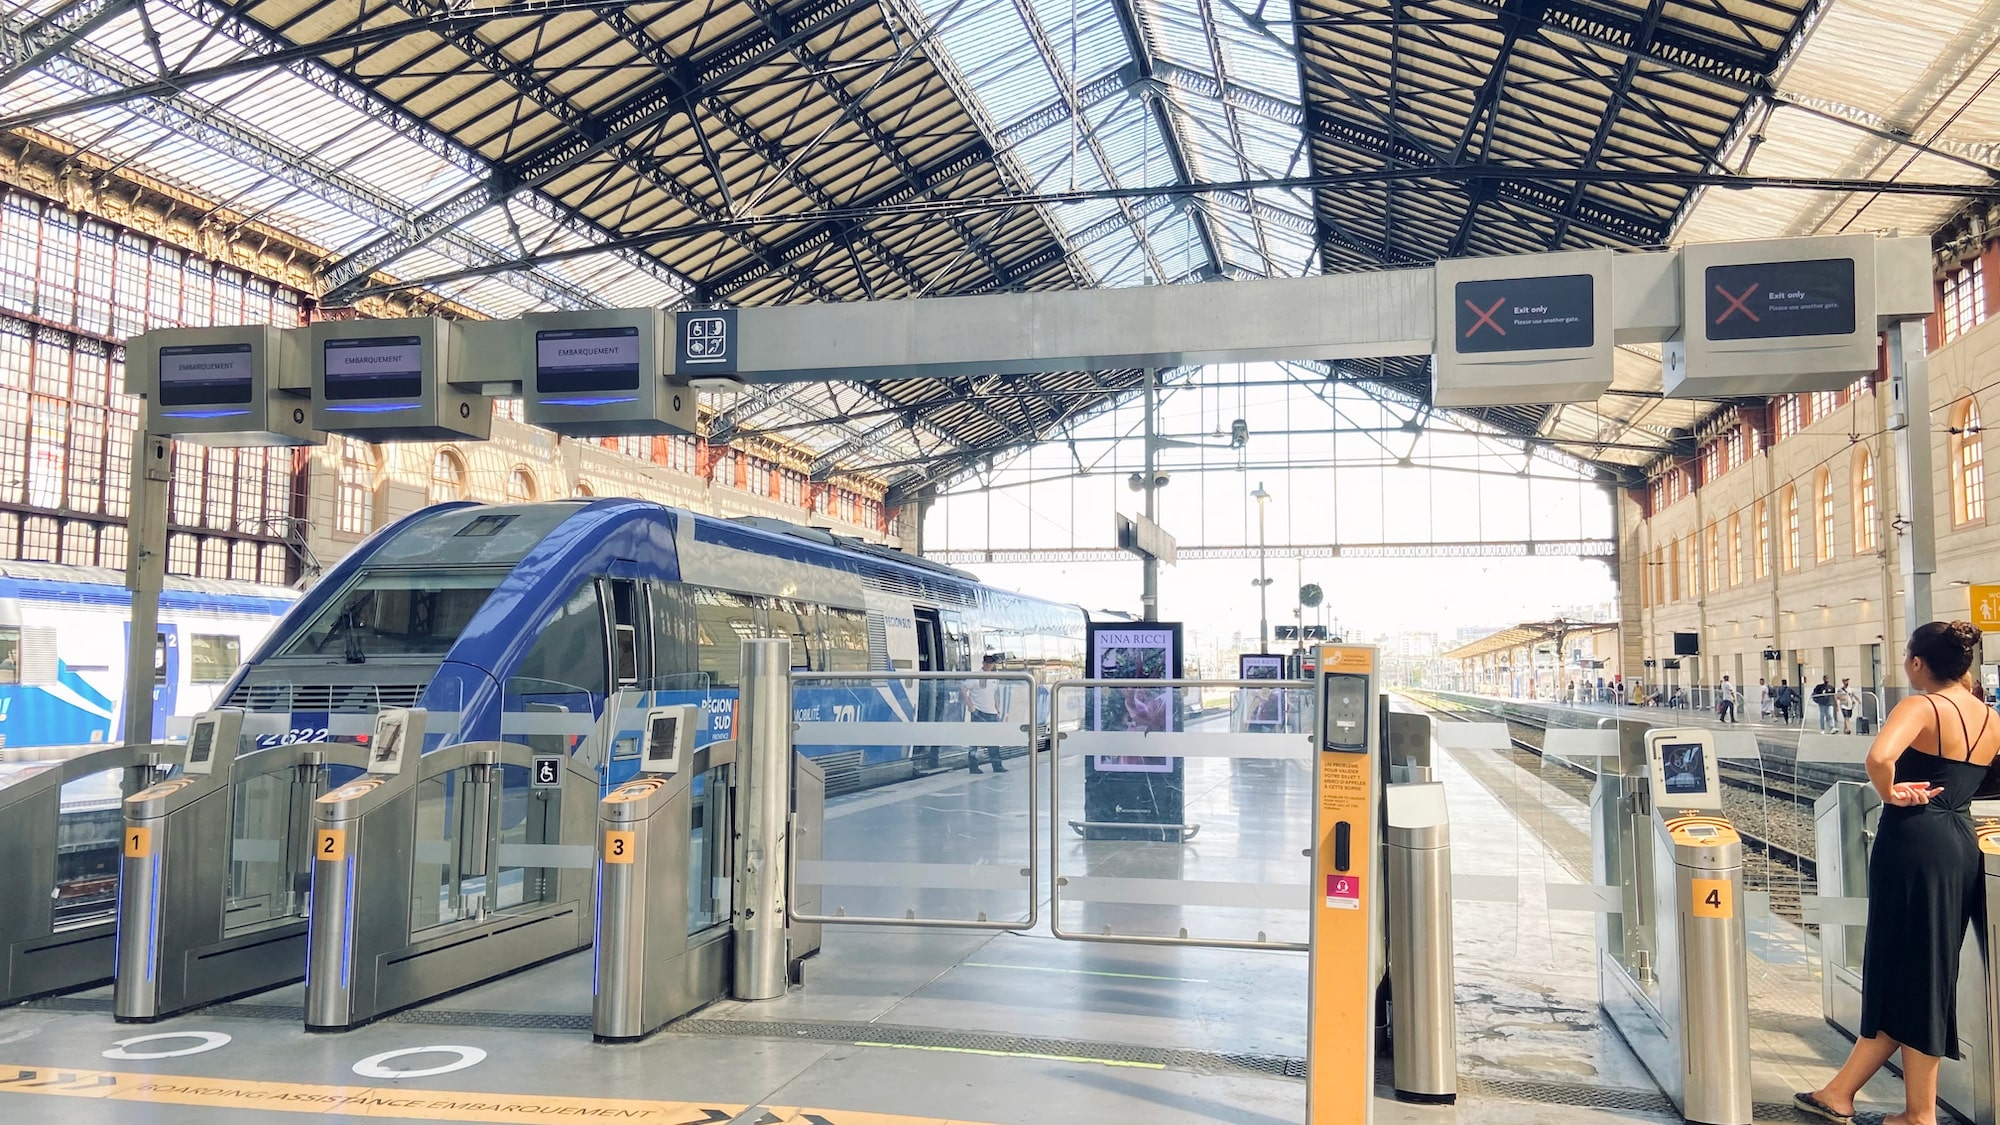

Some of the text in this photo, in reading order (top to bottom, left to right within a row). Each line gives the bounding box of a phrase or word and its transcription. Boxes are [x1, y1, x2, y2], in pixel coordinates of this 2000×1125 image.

[1769, 290, 1805, 300] Exit only
[1514, 305, 1548, 314] Exit only
[557, 346, 619, 356] EMBARQUEMENT
[344, 355, 402, 364] EMBARQUEMENT
[178, 362, 233, 371] EMBARQUEMENT
[1100, 634, 1166, 644] NINA RICCI
[1285, 628, 1295, 640] Z
[1307, 628, 1316, 640] Z
[168, 635, 177, 647] 2
[1772, 651, 1779, 660] Y
[713, 716, 730, 730] SUD
[132, 835, 139, 850] 1
[324, 837, 335, 853] 2
[613, 838, 624, 856] 3
[1705, 889, 1721, 909] 4
[137, 1084, 660, 1118] BOARDING ASSISTANCE EMBARQUEMENT
